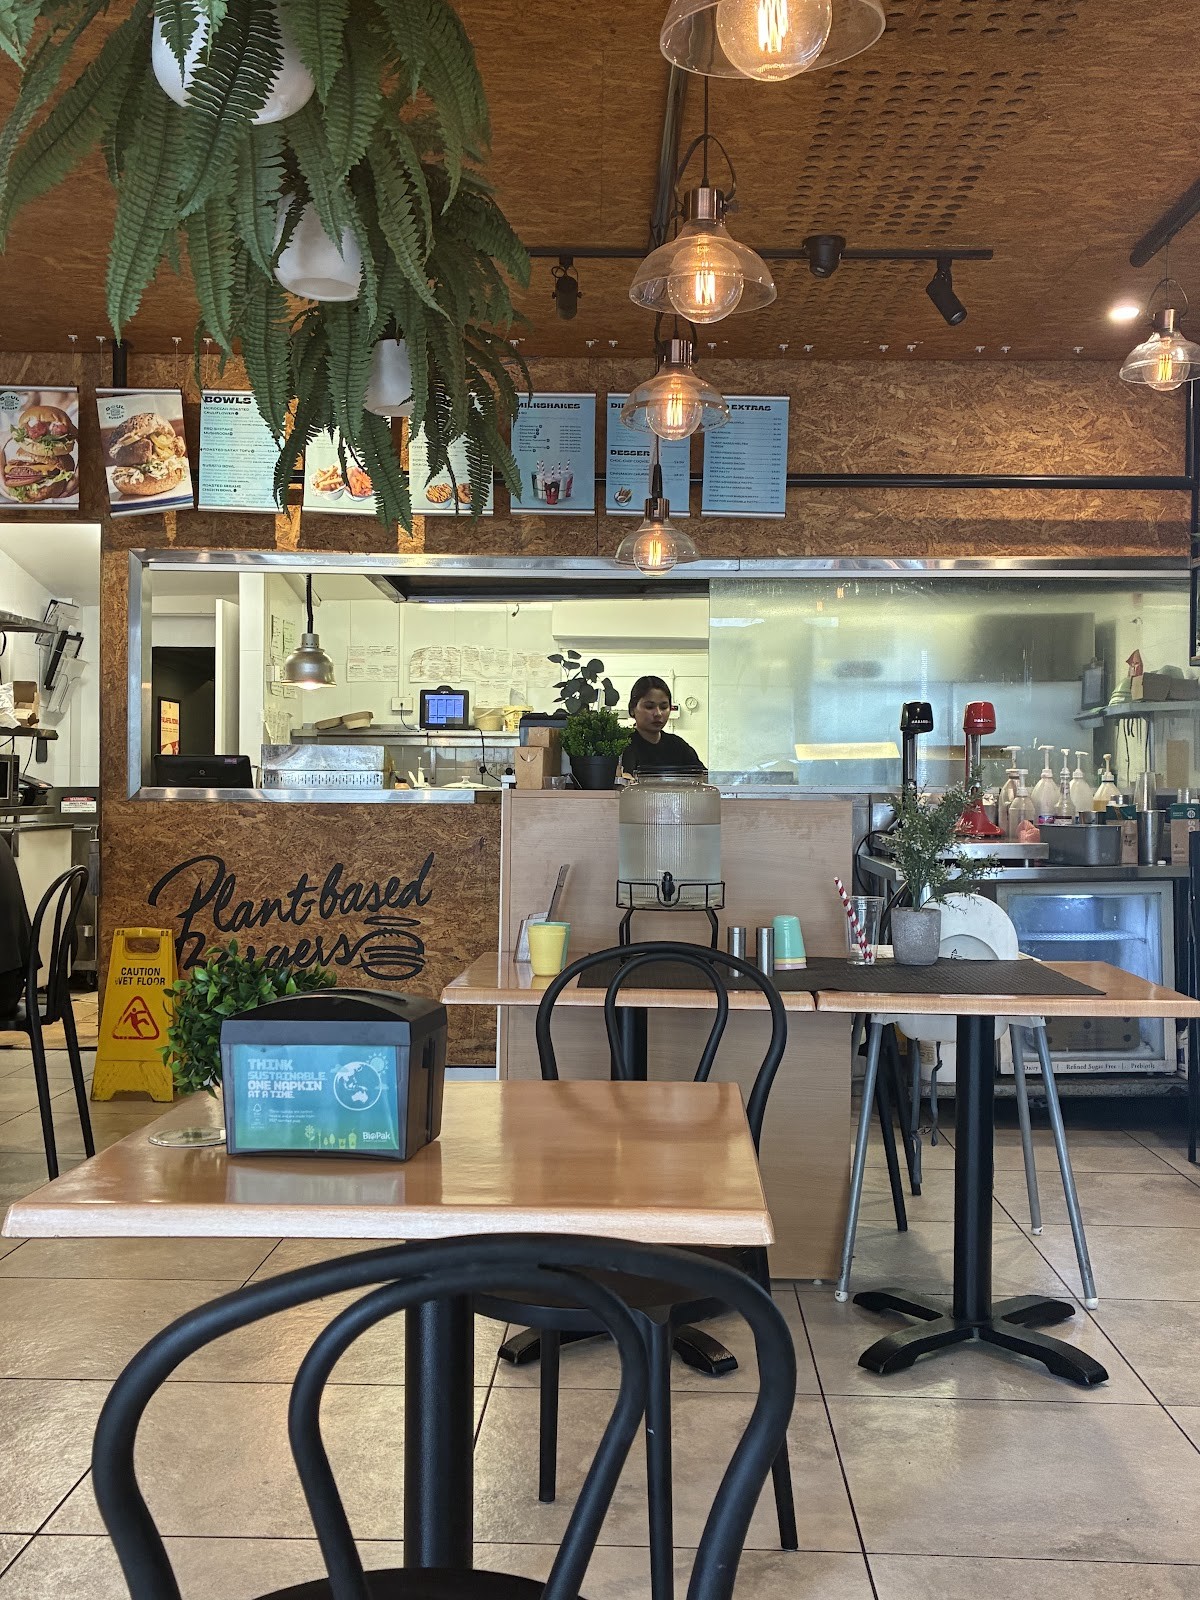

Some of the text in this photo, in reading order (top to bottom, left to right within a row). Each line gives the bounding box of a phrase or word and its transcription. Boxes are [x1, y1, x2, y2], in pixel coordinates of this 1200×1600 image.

[203, 396, 252, 405] BOWLS
[517, 402, 581, 410] MILKSHAKES
[731, 404, 772, 412] EXTRAS
[148, 851, 435, 936] Plant-based
[121, 967, 161, 976] CAUTION
[137, 977, 166, 985] FLOOR
[247, 1058, 293, 1071] THINK
[1088, 1063, 1103, 1071] Sugar
[247, 1080, 323, 1091] ONE NAPKIN
[247, 1090, 261, 1098] AT
[362, 1131, 391, 1140] BioPak
